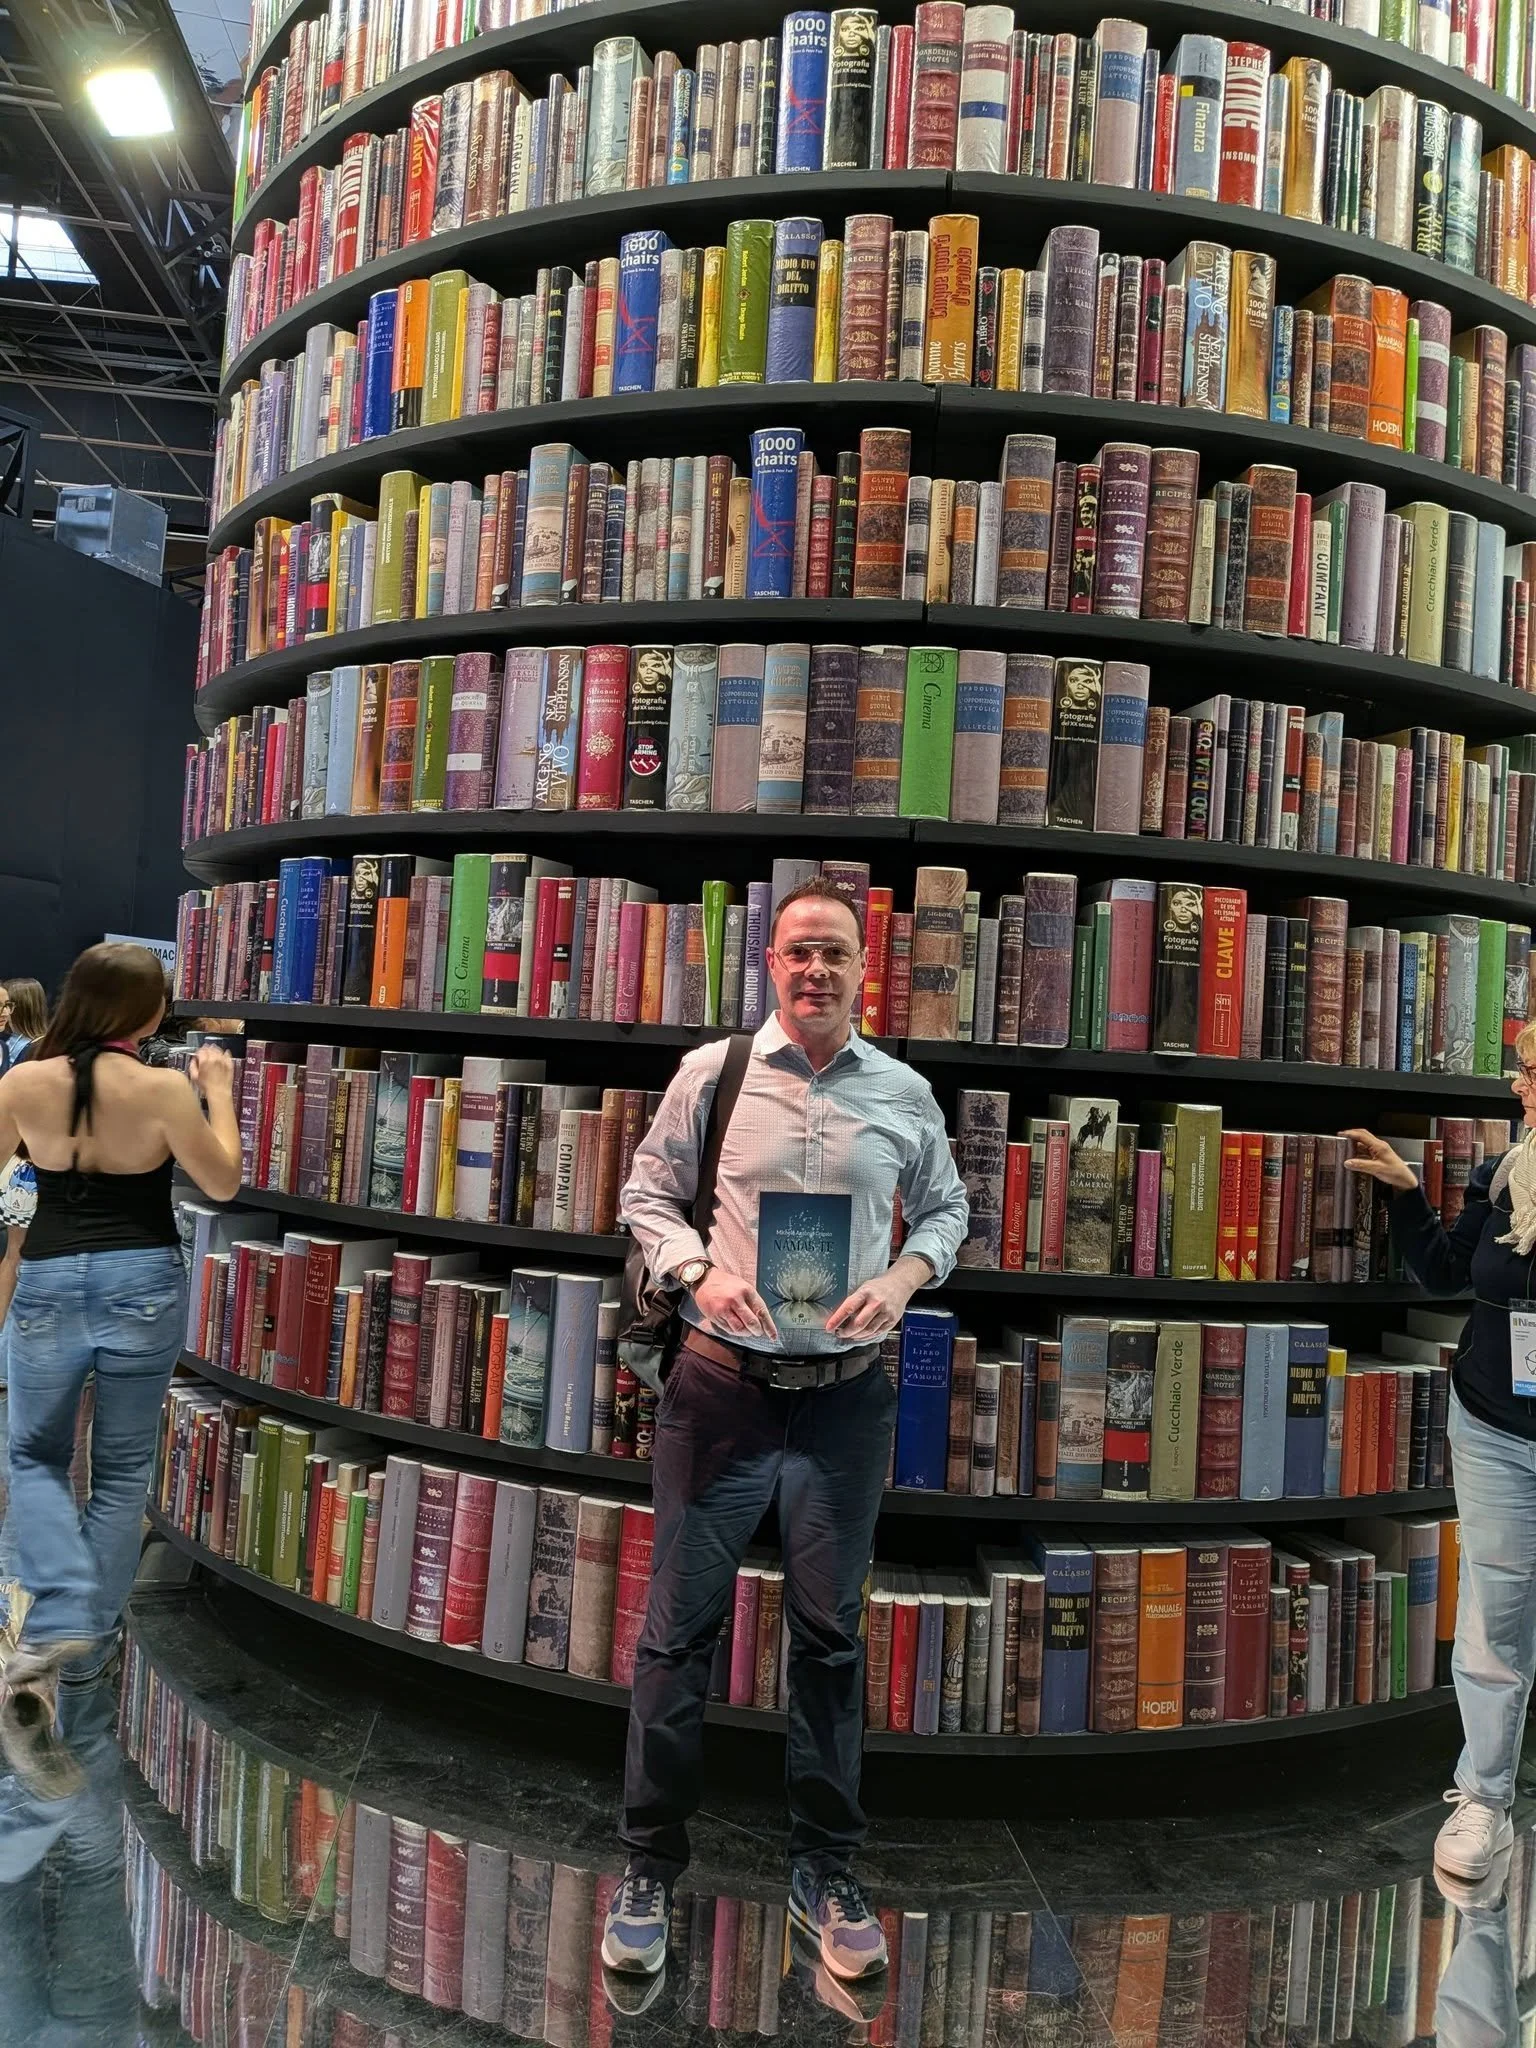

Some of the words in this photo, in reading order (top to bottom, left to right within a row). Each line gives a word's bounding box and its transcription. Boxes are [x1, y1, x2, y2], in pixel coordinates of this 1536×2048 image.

[1224, 66, 1264, 131] KING
[1193, 101, 1203, 153] Finanza
[1423, 106, 1436, 157] MISSIONE
[410, 134, 425, 180] CLAVE
[509, 132, 524, 196] COMPANY
[780, 233, 817, 241] CALASSO
[1416, 202, 1434, 253] BRIAN
[620, 252, 659, 268] chairs
[625, 238, 658, 252] 1000
[777, 284, 809, 294] DIRITTO
[786, 271, 801, 281] DEL
[1101, 285, 1110, 319] POTTER
[1245, 308, 1268, 320] Nudes
[1248, 300, 1267, 309] 1000
[979, 316, 988, 347] LIBRO
[1100, 321, 1109, 353] HARRY
[925, 340, 943, 380] Joanne
[945, 340, 967, 379] Harris
[1210, 337, 1220, 366] NEAL
[1197, 333, 1210, 408] STEPHENSON
[755, 452, 797, 468] chairs
[758, 438, 796, 452] 1000
[936, 483, 948, 525] italiana
[1155, 490, 1192, 500] RECIPES
[736, 514, 746, 552] Cucina
[934, 527, 947, 566] Cucina
[1430, 519, 1440, 553] Verde
[1314, 552, 1329, 620] COMPANY
[1426, 555, 1438, 613] Cucchiaio
[555, 654, 571, 722] STEPHENSON
[632, 698, 667, 706] Fotografia
[546, 695, 556, 721] NEAL
[922, 682, 942, 730] Cinema
[1059, 712, 1097, 723] Fotografia
[1056, 816, 1083, 825] TASCHEN
[277, 898, 289, 948] Cucchiaio
[749, 902, 760, 911] A
[747, 912, 761, 968] THOUSAND
[867, 914, 882, 973] English
[880, 915, 889, 974] MACMILLAN
[1163, 935, 1199, 945] Fotografia
[1216, 928, 1234, 979] CLAVE
[1314, 937, 1345, 946] RECIPES
[455, 935, 472, 980] Cinema
[622, 959, 638, 998] Citazioni
[744, 969, 759, 1012] HOUNDS
[1404, 1005, 1412, 1014] R
[1487, 1001, 1499, 1044] Cinema
[1163, 1041, 1189, 1049] TASCHEN
[335, 1139, 341, 1148] R
[519, 1132, 527, 1151] LUPI
[525, 1115, 536, 1152] L'IMPERO
[556, 1143, 573, 1211] COMPANY
[1052, 1148, 1062, 1196] SANCTORUM
[1075, 1171, 1110, 1180] INDIANI
[1198, 1135, 1206, 1187] COSTITUZIONALE
[1070, 1179, 1112, 1189] D'AMERICA
[1222, 1158, 1237, 1218] English
[1245, 1158, 1257, 1218] English
[1008, 1201, 1022, 1245] Mitologia
[1117, 1204, 1128, 1243] L'IMPERO
[226, 1258, 237, 1295] HOUNDS
[488, 1320, 505, 1396] FOTOGRAFIA
[912, 1347, 940, 1356] LIBRO
[1171, 1339, 1184, 1378] Verde
[1294, 1341, 1327, 1349] CALASSO
[475, 1368, 484, 1386] LUPI
[1213, 1381, 1235, 1389] NOTES
[1290, 1368, 1313, 1378] MEDIO
[1314, 1368, 1326, 1377] EVO
[1302, 1382, 1316, 1392] DEL
[474, 1387, 482, 1403] DEI
[1168, 1381, 1182, 1443] Cucchiaio
[1292, 1394, 1321, 1404] DIRITTO
[1353, 1381, 1363, 1455] FOTOGRAFIA
[915, 1475, 924, 1485] S
[317, 1491, 330, 1561] FOTOGRAFIA
[1053, 1569, 1090, 1577] CALASSO
[1049, 1598, 1074, 1607] MEDIO
[1077, 1598, 1090, 1607] EVO
[1101, 1595, 1137, 1604] RECIPES
[733, 1602, 748, 1641] Citazioni
[1051, 1625, 1085, 1636] DIRITTO
[1061, 1612, 1077, 1622] DEL
[893, 1663, 908, 1707] Mitologia
[1142, 1700, 1179, 1715] HOEPLI
[1245, 1700, 1253, 1709] S
